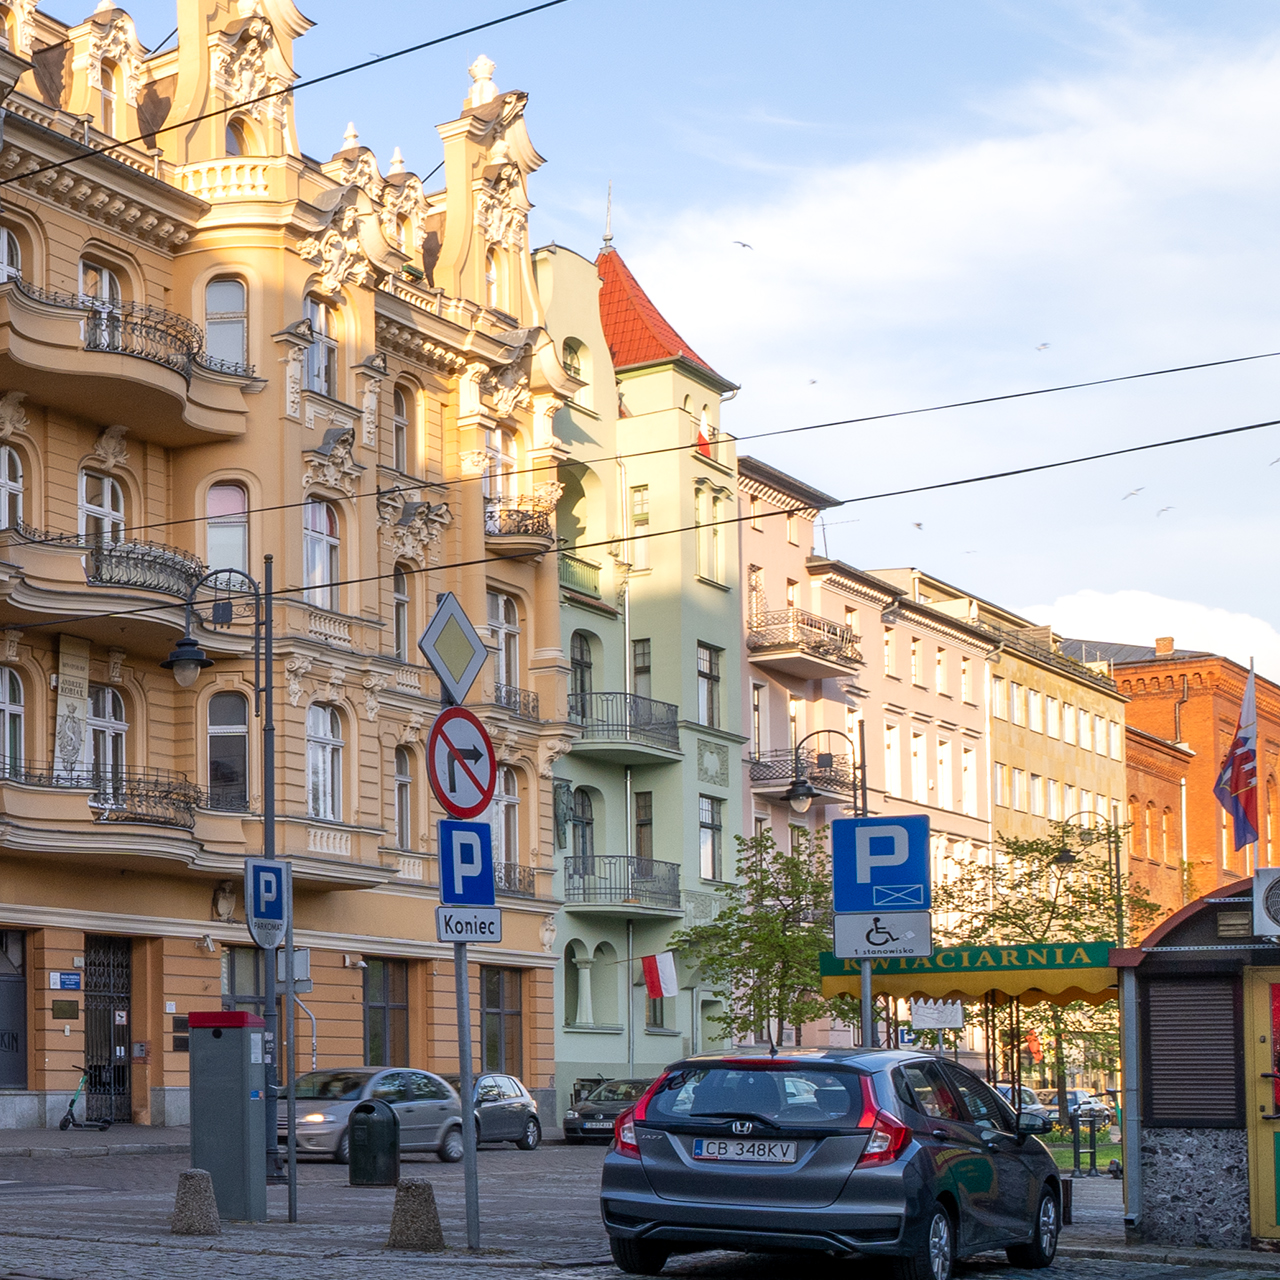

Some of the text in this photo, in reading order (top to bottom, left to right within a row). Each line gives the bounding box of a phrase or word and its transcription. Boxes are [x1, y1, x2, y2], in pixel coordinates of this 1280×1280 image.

[60, 686, 84, 698] KOBIAK
[451, 830, 483, 895] P
[855, 825, 909, 884] P
[260, 872, 277, 913] P
[254, 922, 283, 932] PARKOMAT
[444, 914, 495, 935] Koniec
[843, 947, 1092, 971] KWIACIARNIA
[862, 947, 914, 956] stanowisko
[706, 1141, 728, 1156] CB
[735, 1142, 791, 1158] 348KV
